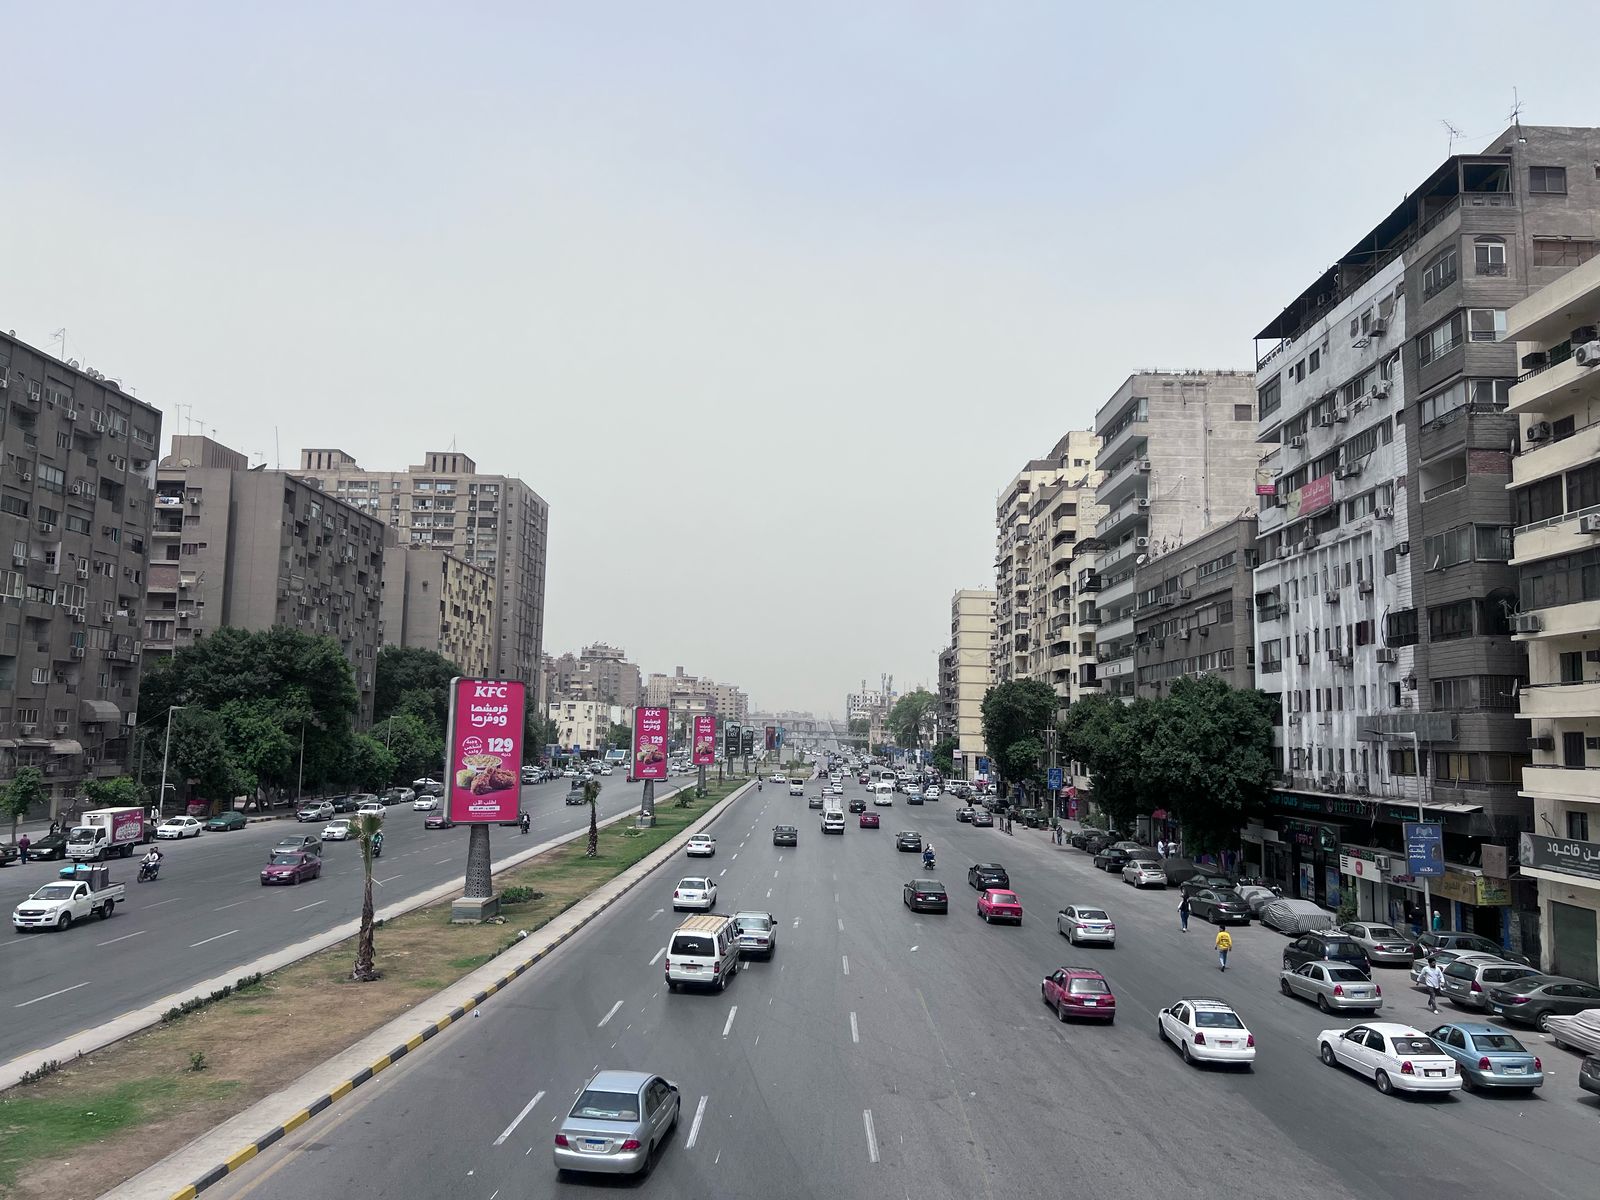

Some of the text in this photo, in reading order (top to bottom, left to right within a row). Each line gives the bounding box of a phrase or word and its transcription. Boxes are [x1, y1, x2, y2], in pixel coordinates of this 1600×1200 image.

[474, 686, 507, 698] KFC
[471, 703, 508, 714] قرمشها
[487, 737, 513, 752] 129
[1547, 842, 1580, 857] قاعود
